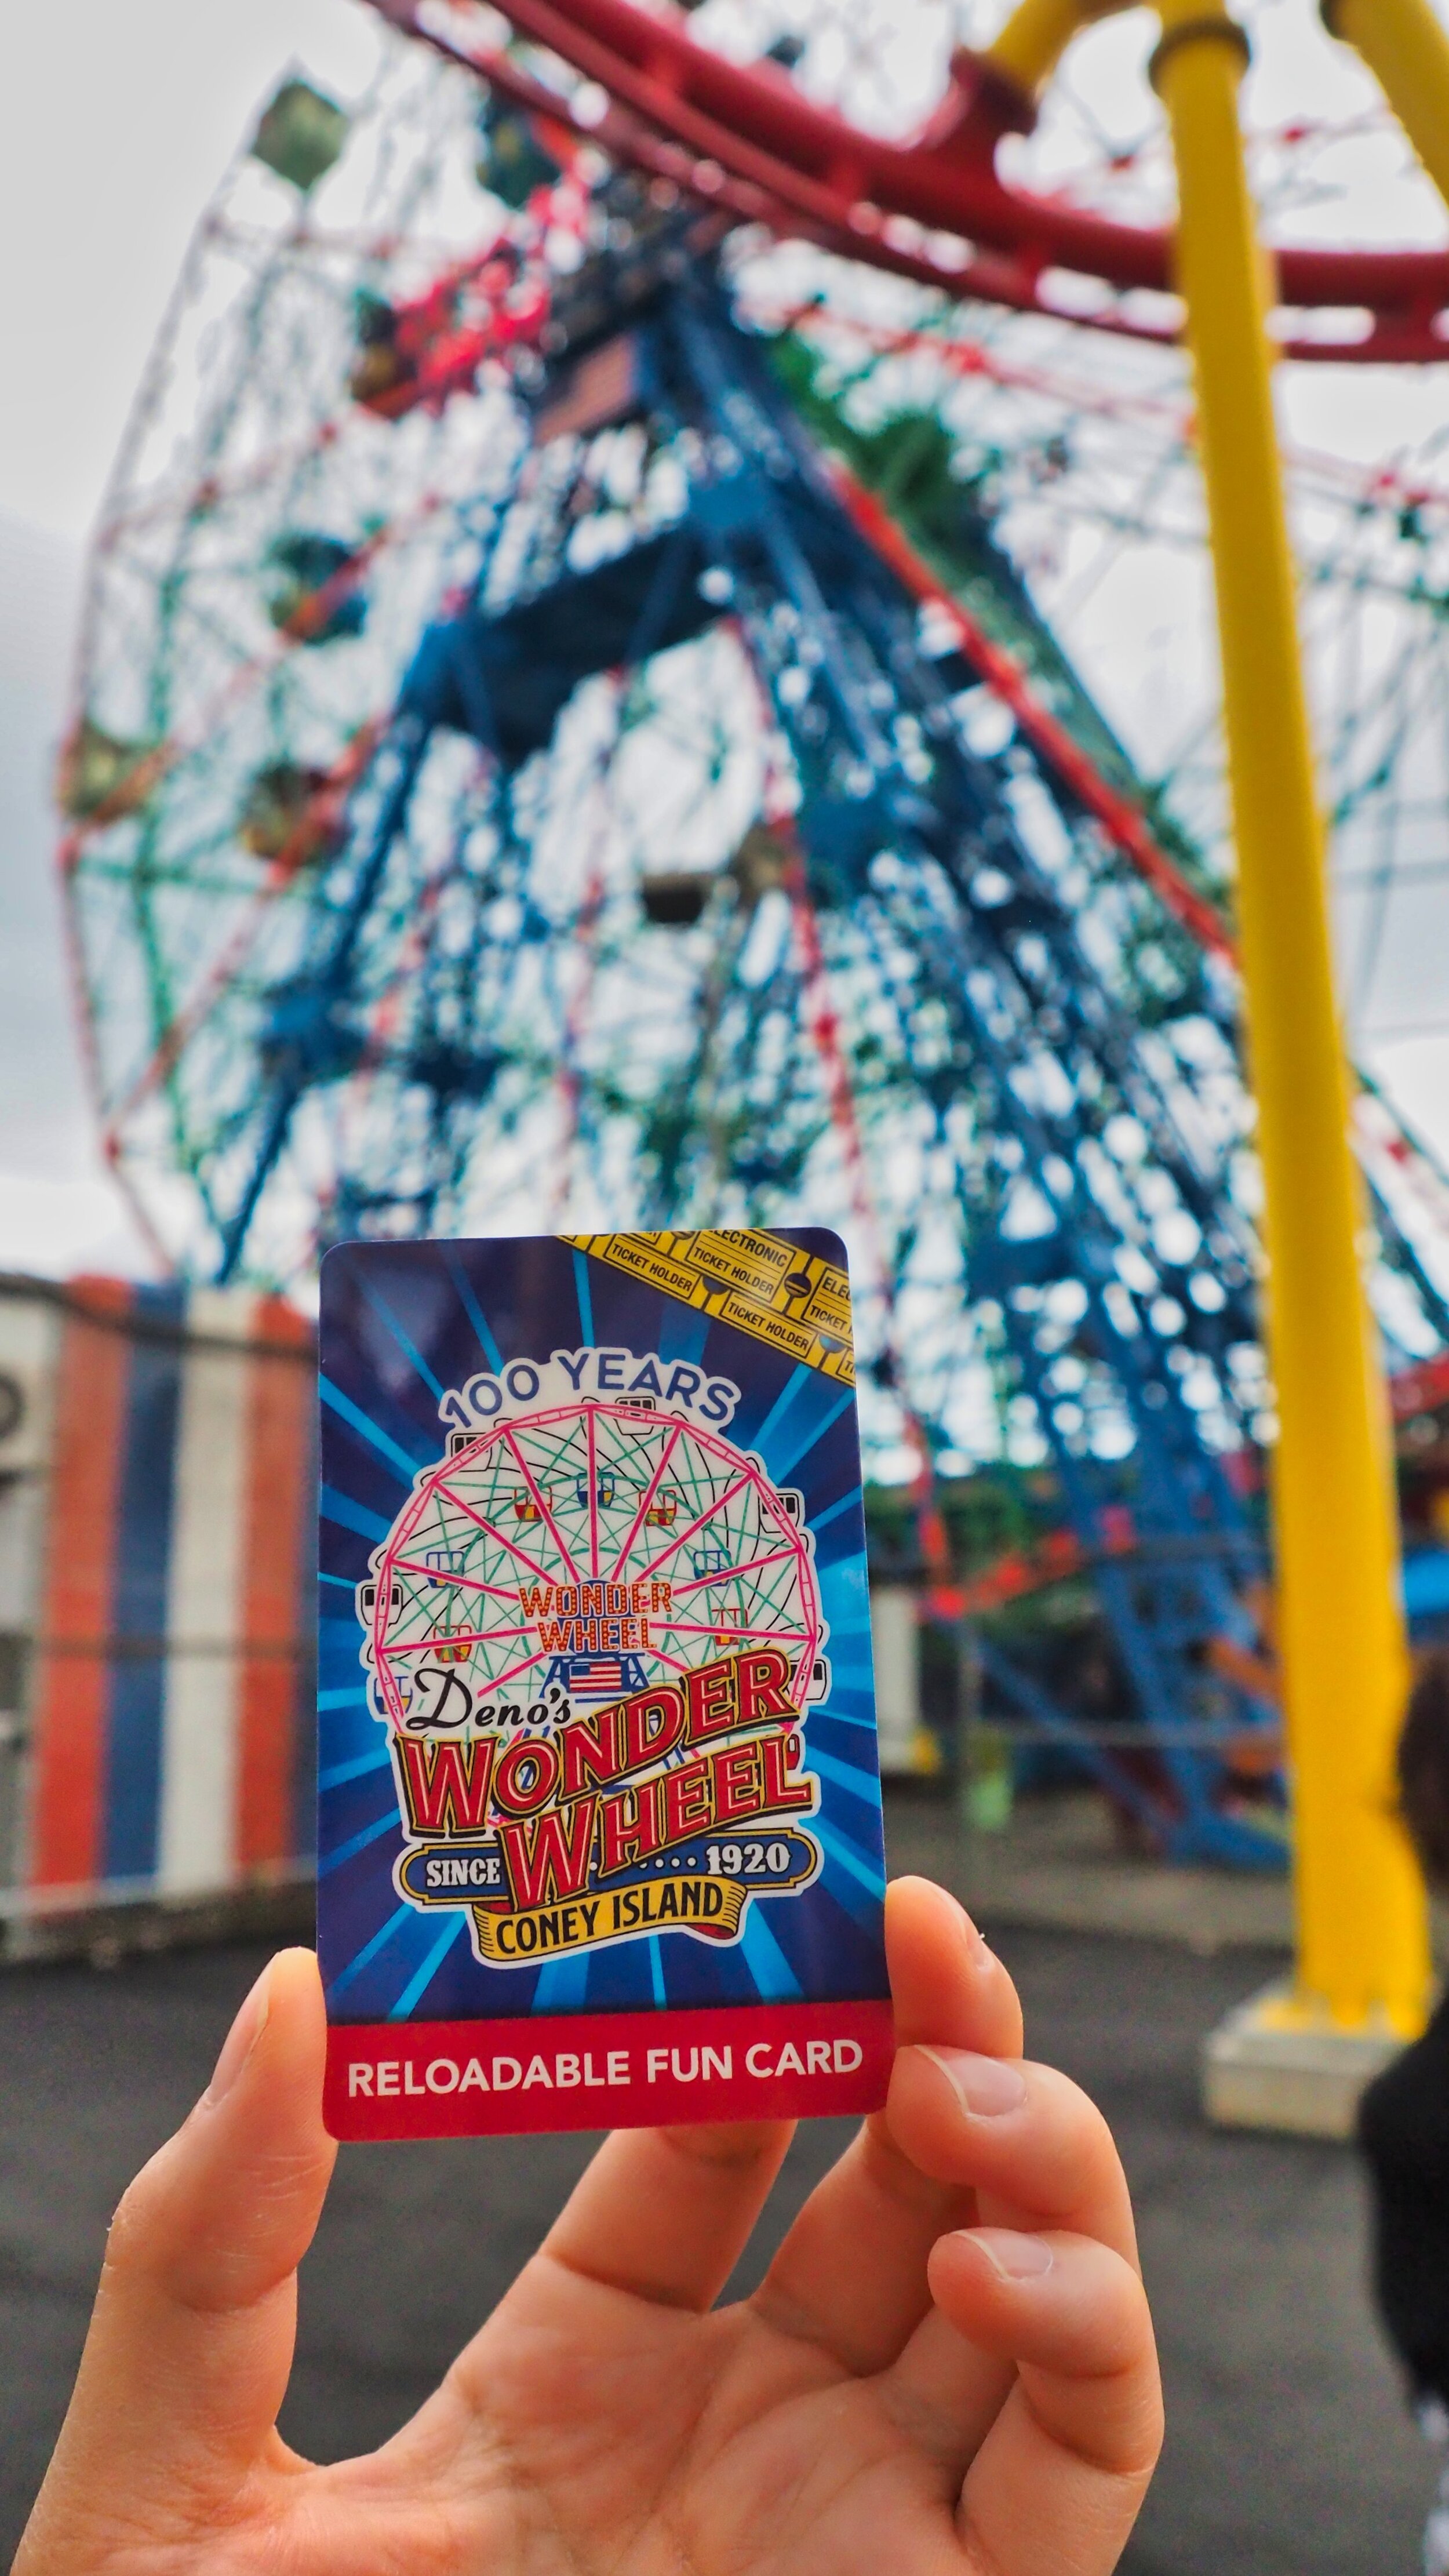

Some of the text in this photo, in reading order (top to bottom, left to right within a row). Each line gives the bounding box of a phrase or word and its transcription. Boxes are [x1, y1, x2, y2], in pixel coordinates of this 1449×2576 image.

[612, 1243, 692, 1291] TICKET HOLDER
[694, 1247, 774, 1294] TICKET HOLDER
[708, 1229, 788, 1267] LECTRONIC
[728, 1302, 809, 1351] TICKET HOLDER
[810, 1305, 848, 1330] TICKET
[445, 1353, 735, 1428] 100 YEARS
[519, 1582, 672, 1617] WONDER
[537, 1618, 657, 1652] WHEEL
[406, 1668, 571, 1730] Deno's
[395, 1647, 801, 1839] WONDER
[499, 1732, 814, 1914] WHEEL
[425, 1842, 792, 1887] SINCE 1920
[496, 1882, 723, 1954] CONEY ISLAND
[348, 2039, 864, 2097] RELOADABLE FUN CARD
